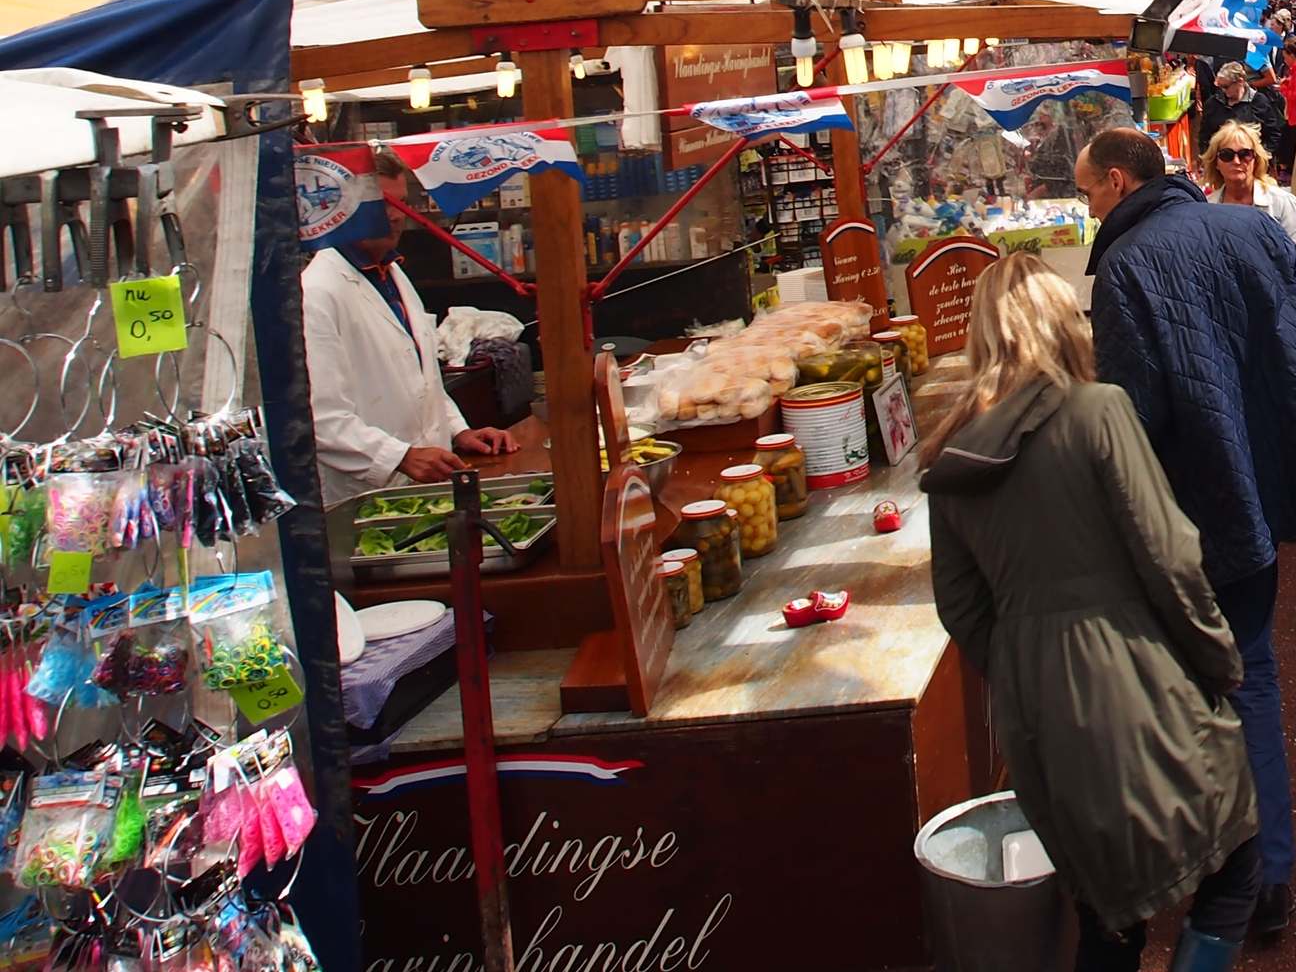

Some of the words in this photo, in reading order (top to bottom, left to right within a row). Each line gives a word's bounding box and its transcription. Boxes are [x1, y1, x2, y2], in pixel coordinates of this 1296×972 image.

[314, 157, 353, 180] NIEUWE
[465, 161, 508, 181] GEZOND
[306, 210, 346, 237] LEKKER
[124, 288, 151, 301] nu
